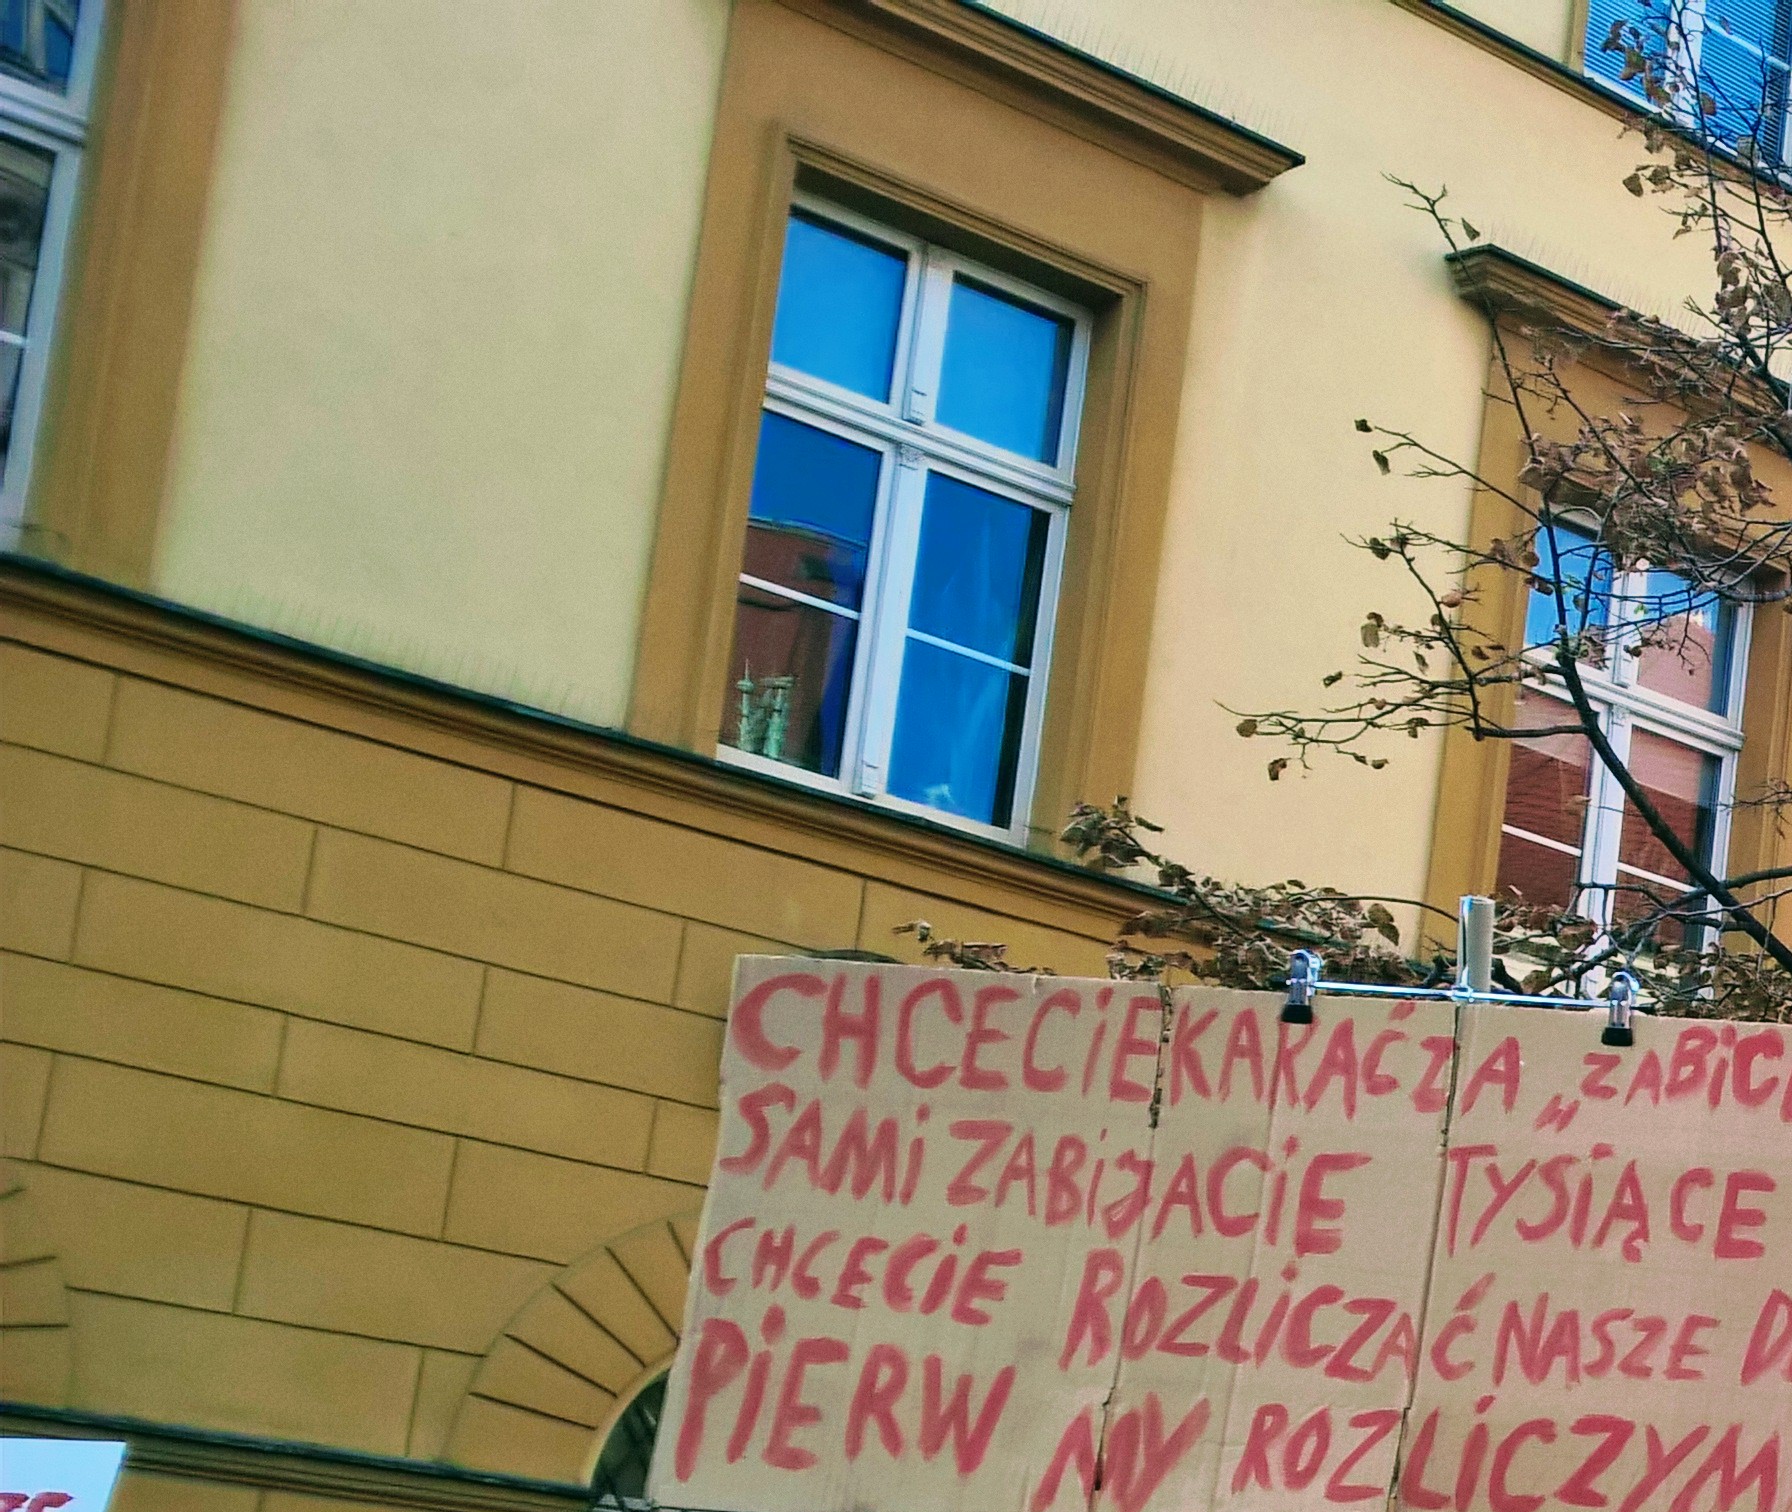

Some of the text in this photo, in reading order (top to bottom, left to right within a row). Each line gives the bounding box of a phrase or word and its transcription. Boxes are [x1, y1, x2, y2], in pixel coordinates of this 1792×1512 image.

[721, 1083, 930, 1205] SAMI
[946, 1120, 1373, 1254] ZABIJACIE
[704, 1217, 1022, 1325] CHCECIE
[1493, 1293, 1721, 1390] NASZE
[674, 1304, 1017, 1483] PIERW
